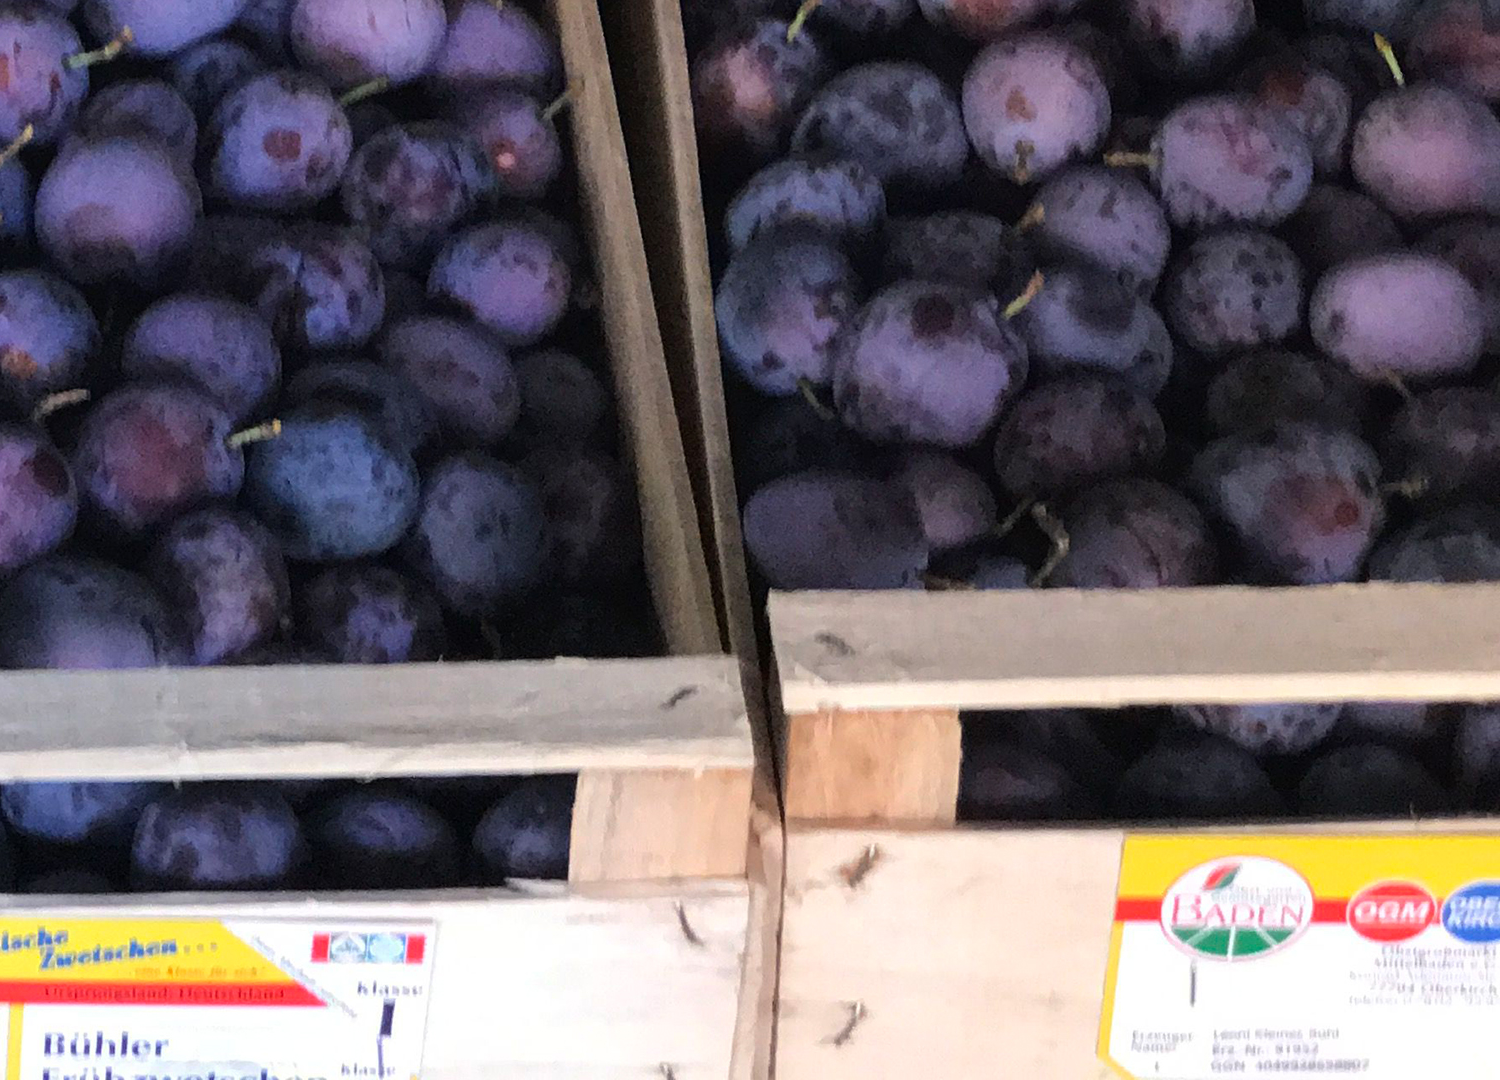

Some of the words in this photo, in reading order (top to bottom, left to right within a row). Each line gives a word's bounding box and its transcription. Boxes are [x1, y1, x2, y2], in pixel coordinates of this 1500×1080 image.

[1171, 894, 1304, 925] BADEN
[1355, 900, 1431, 924] OGM
[43, 1030, 169, 1057] Bühler
